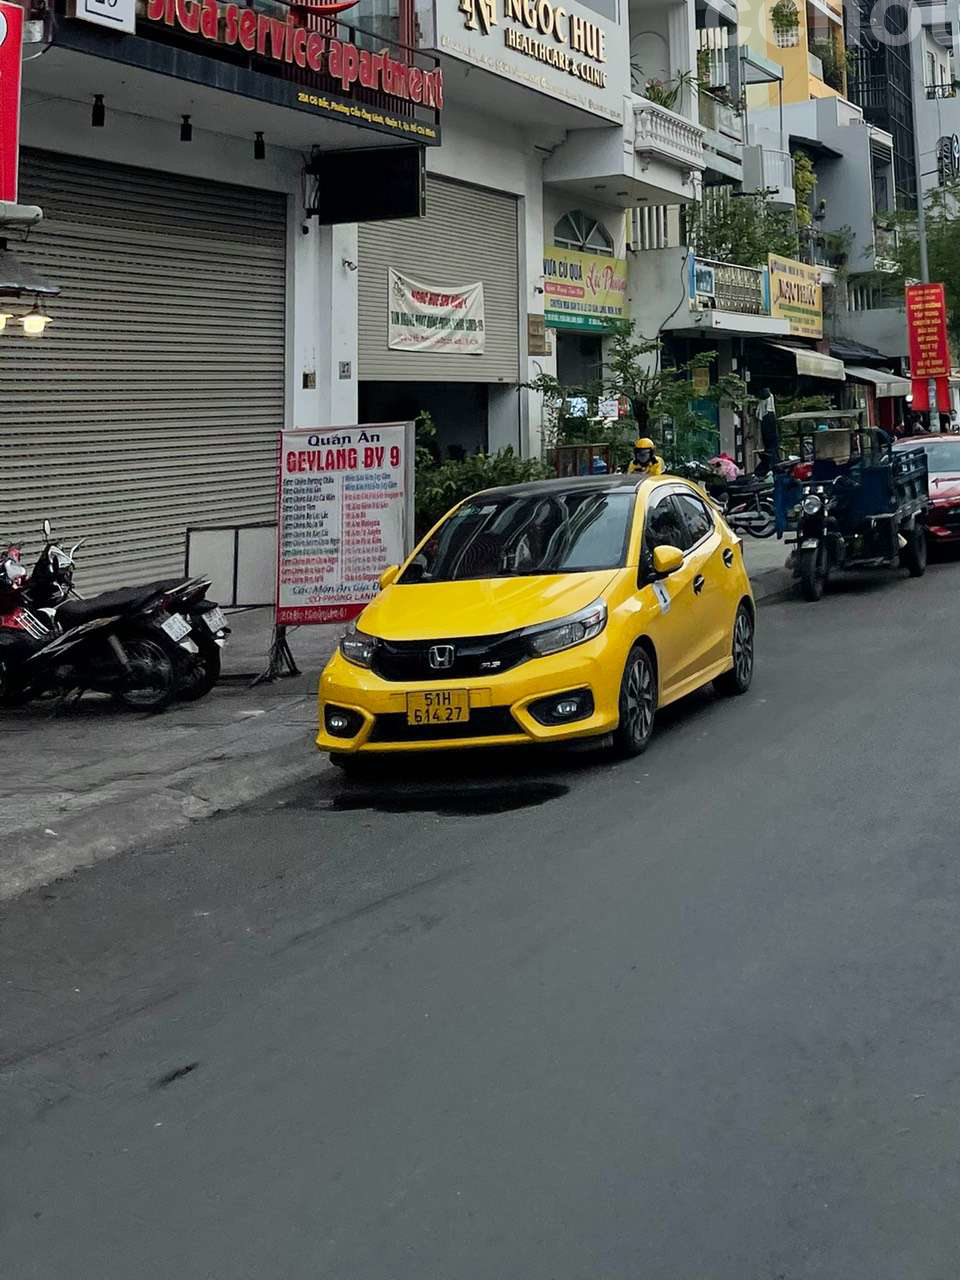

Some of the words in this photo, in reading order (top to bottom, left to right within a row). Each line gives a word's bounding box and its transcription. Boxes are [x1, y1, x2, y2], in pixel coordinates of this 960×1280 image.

[226, 4, 323, 71] service
[329, 40, 443, 109] apartment
[505, 27, 571, 72] HEALTHCARE
[570, 62, 580, 76] &
[581, 62, 608, 88] CLINIC
[569, 14, 607, 63] HUE
[307, 433, 351, 447] Quán
[358, 430, 380, 443] Ăn
[287, 447, 358, 473] GEYLANG
[390, 445, 400, 467] 9
[424, 691, 451, 706] 51H
